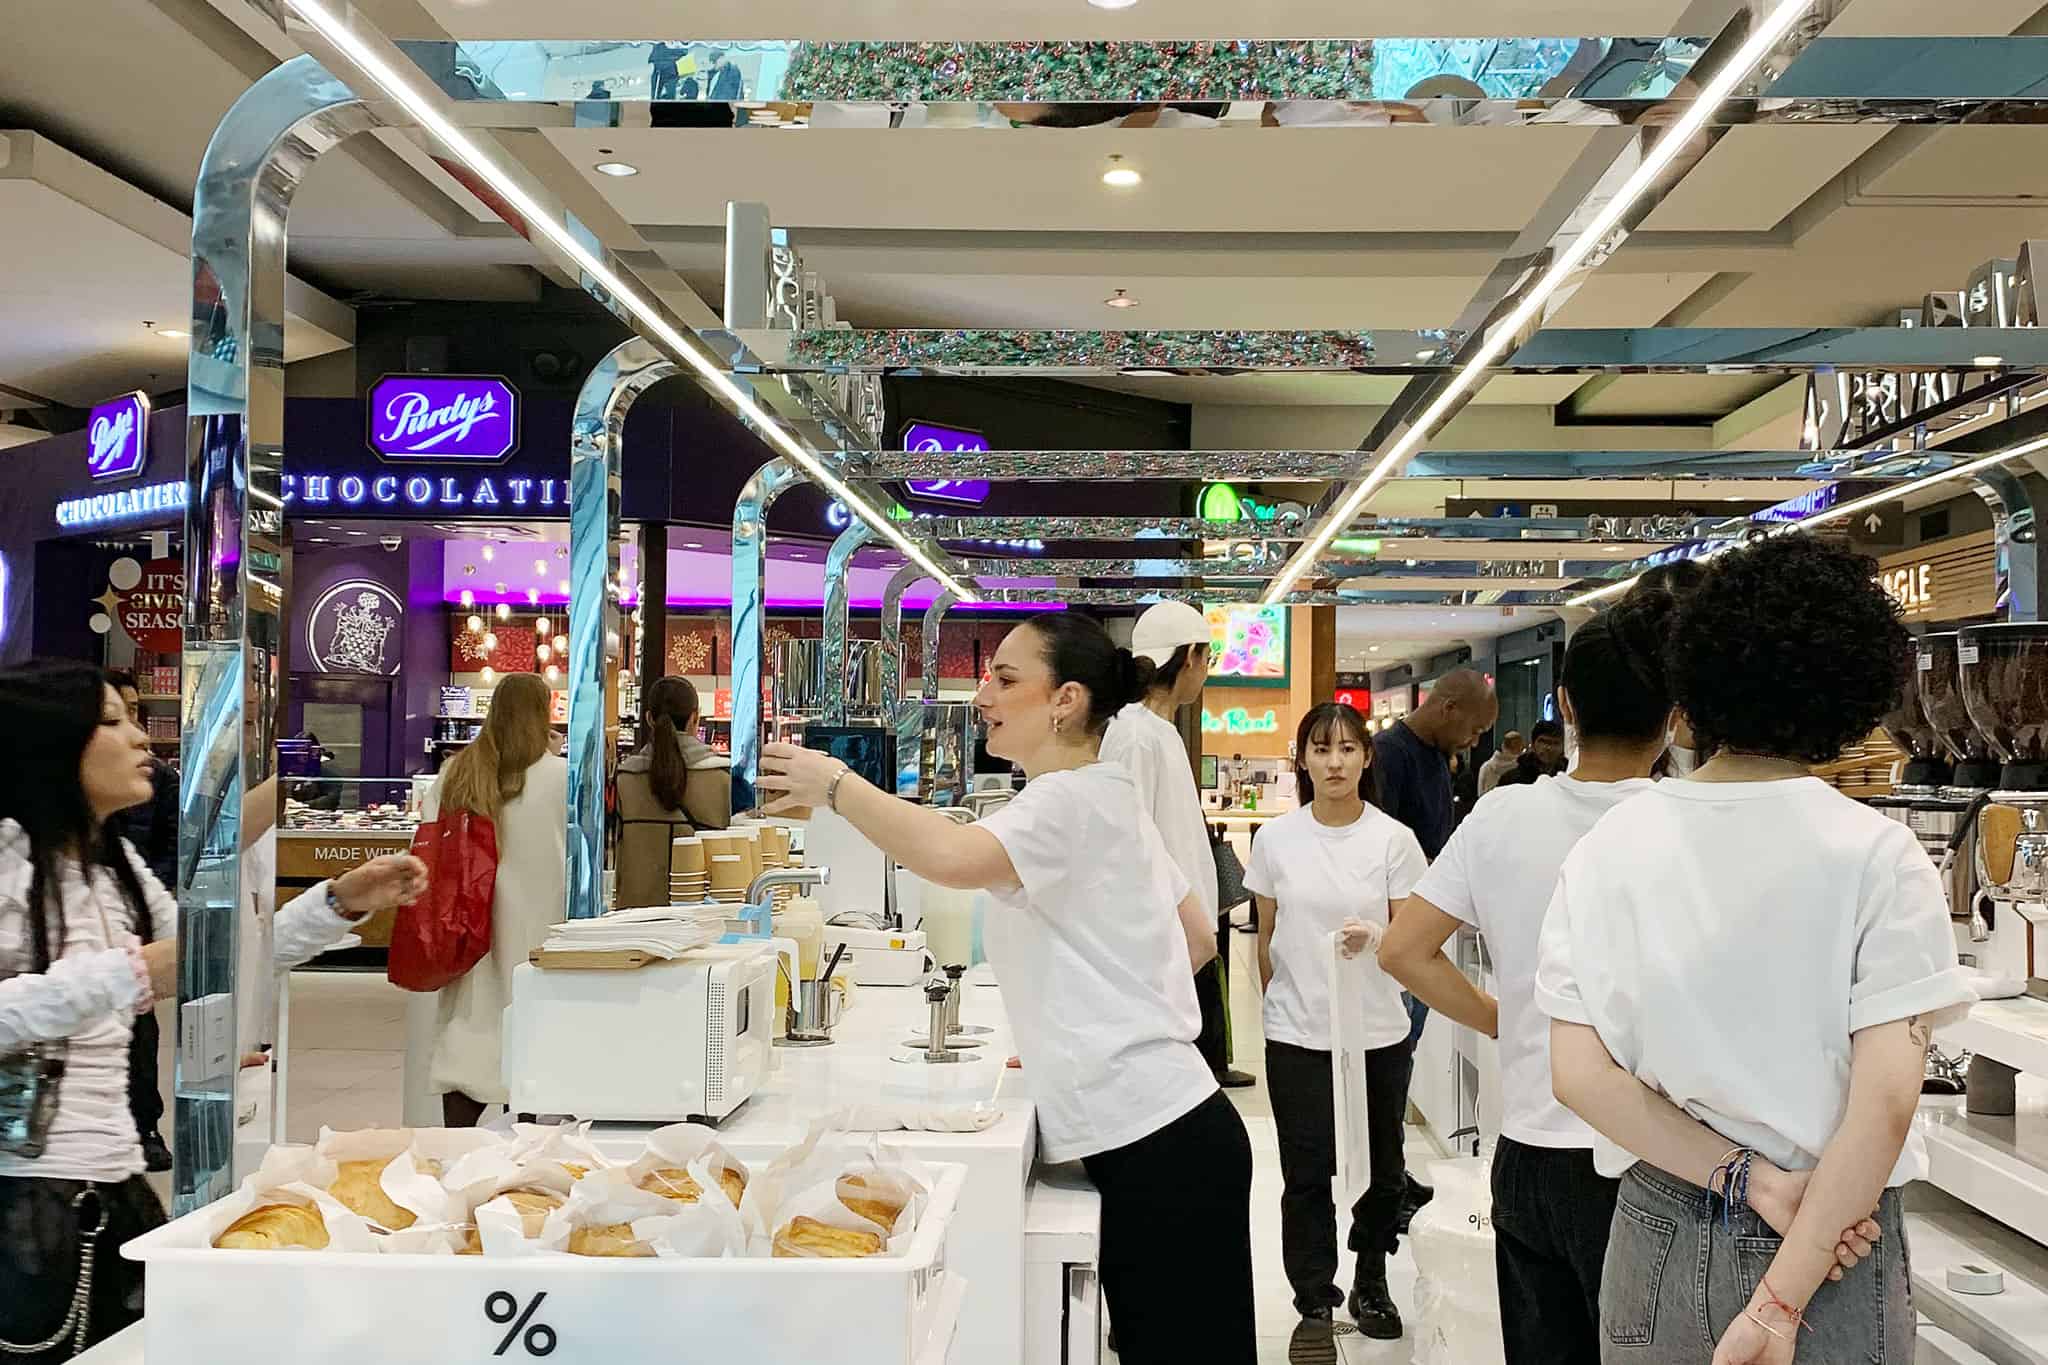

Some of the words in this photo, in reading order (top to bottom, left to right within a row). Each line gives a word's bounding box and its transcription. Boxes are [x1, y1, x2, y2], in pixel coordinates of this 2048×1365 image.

[379, 391, 500, 450] Purdys
[281, 473, 572, 505] CHOCOLATI
[147, 574, 185, 590] IT'S
[314, 847, 361, 860] MADE
[484, 1290, 557, 1357] %
